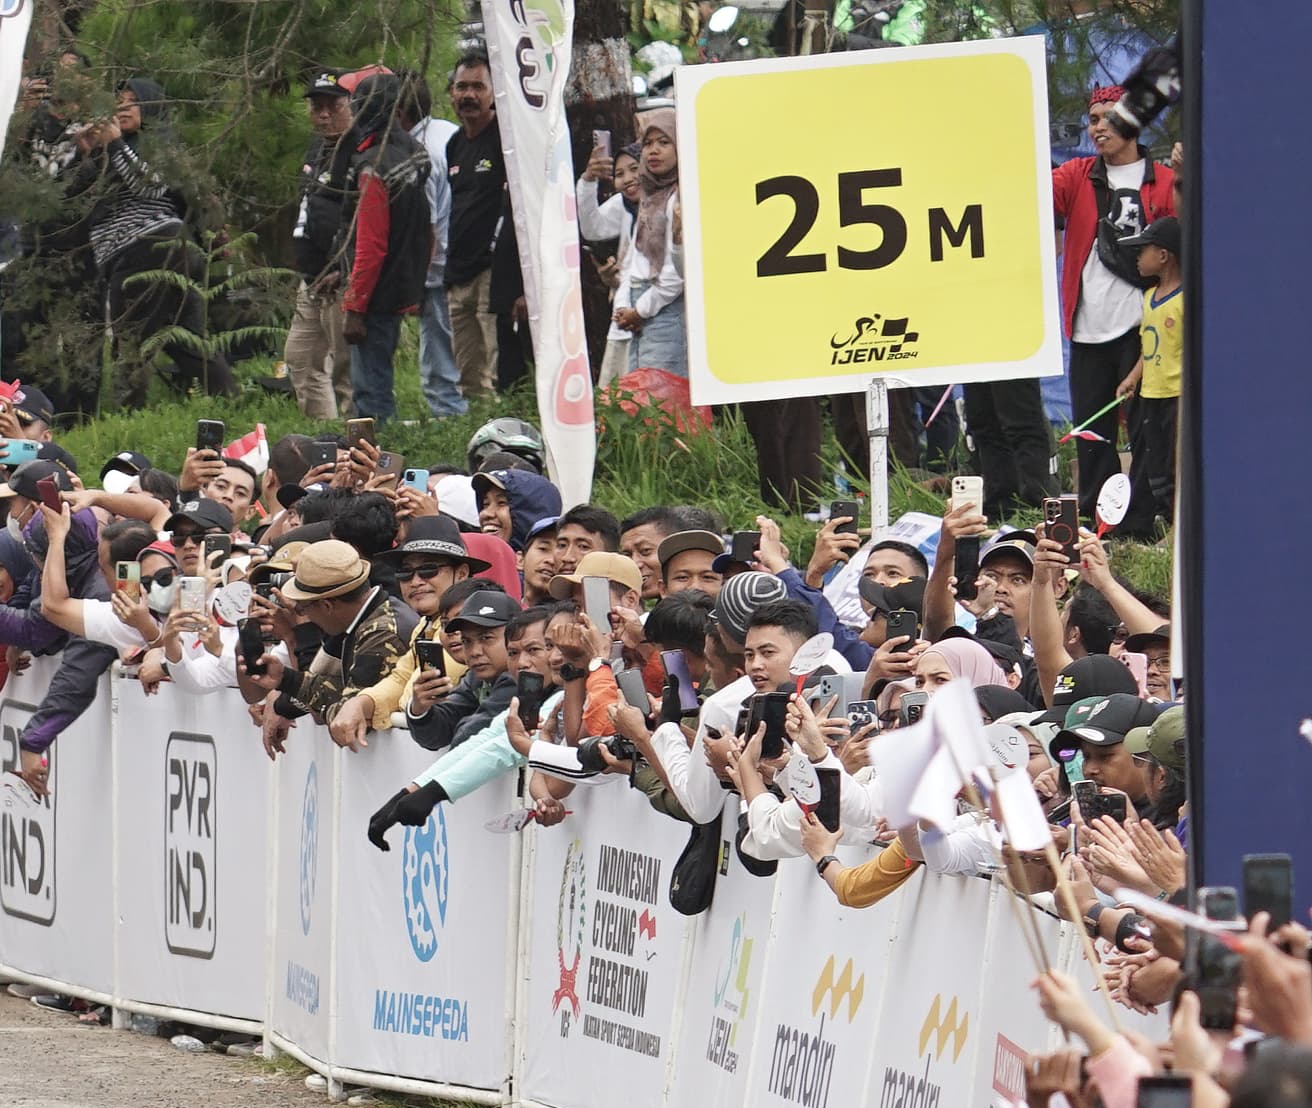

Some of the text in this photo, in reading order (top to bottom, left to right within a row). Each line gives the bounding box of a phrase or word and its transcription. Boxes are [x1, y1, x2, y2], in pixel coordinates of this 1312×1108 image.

[755, 167, 985, 277] 25 M
[831, 346, 918, 365] IJEN 2024
[169, 757, 212, 839] PVR
[596, 844, 662, 906] INDONESIAN
[592, 899, 637, 957] CYCLING
[373, 989, 469, 1043] MAINSEPEDA
[586, 955, 649, 1018] FEDERATION
[601, 1019, 618, 1046] SPORT
